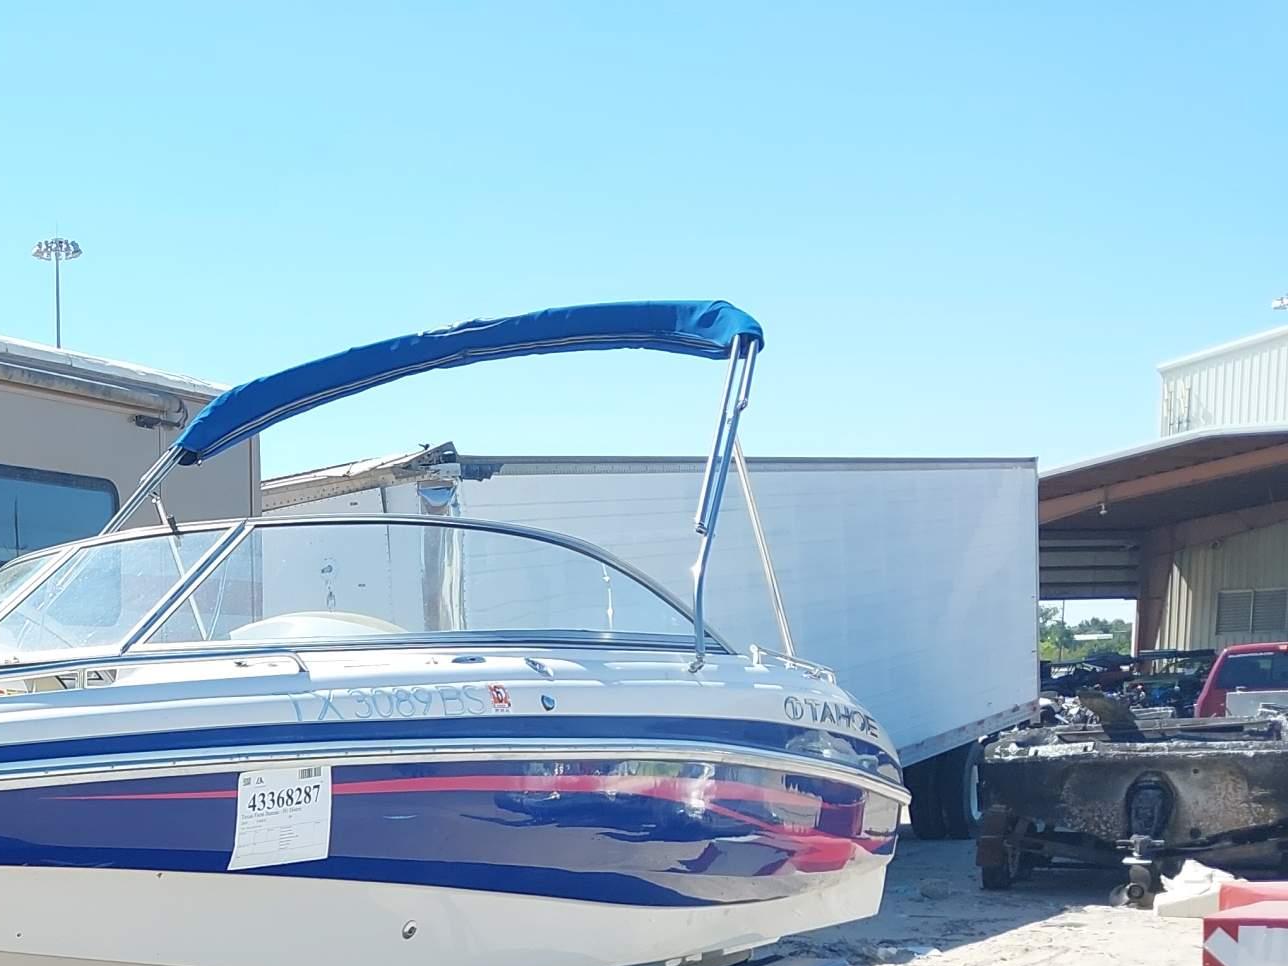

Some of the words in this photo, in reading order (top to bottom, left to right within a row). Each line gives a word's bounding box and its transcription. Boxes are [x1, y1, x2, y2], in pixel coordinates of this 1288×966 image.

[347, 687, 432, 719] 3089
[435, 685, 486, 716] BS
[803, 698, 879, 739] TAHOE
[247, 784, 320, 812] 43368287
